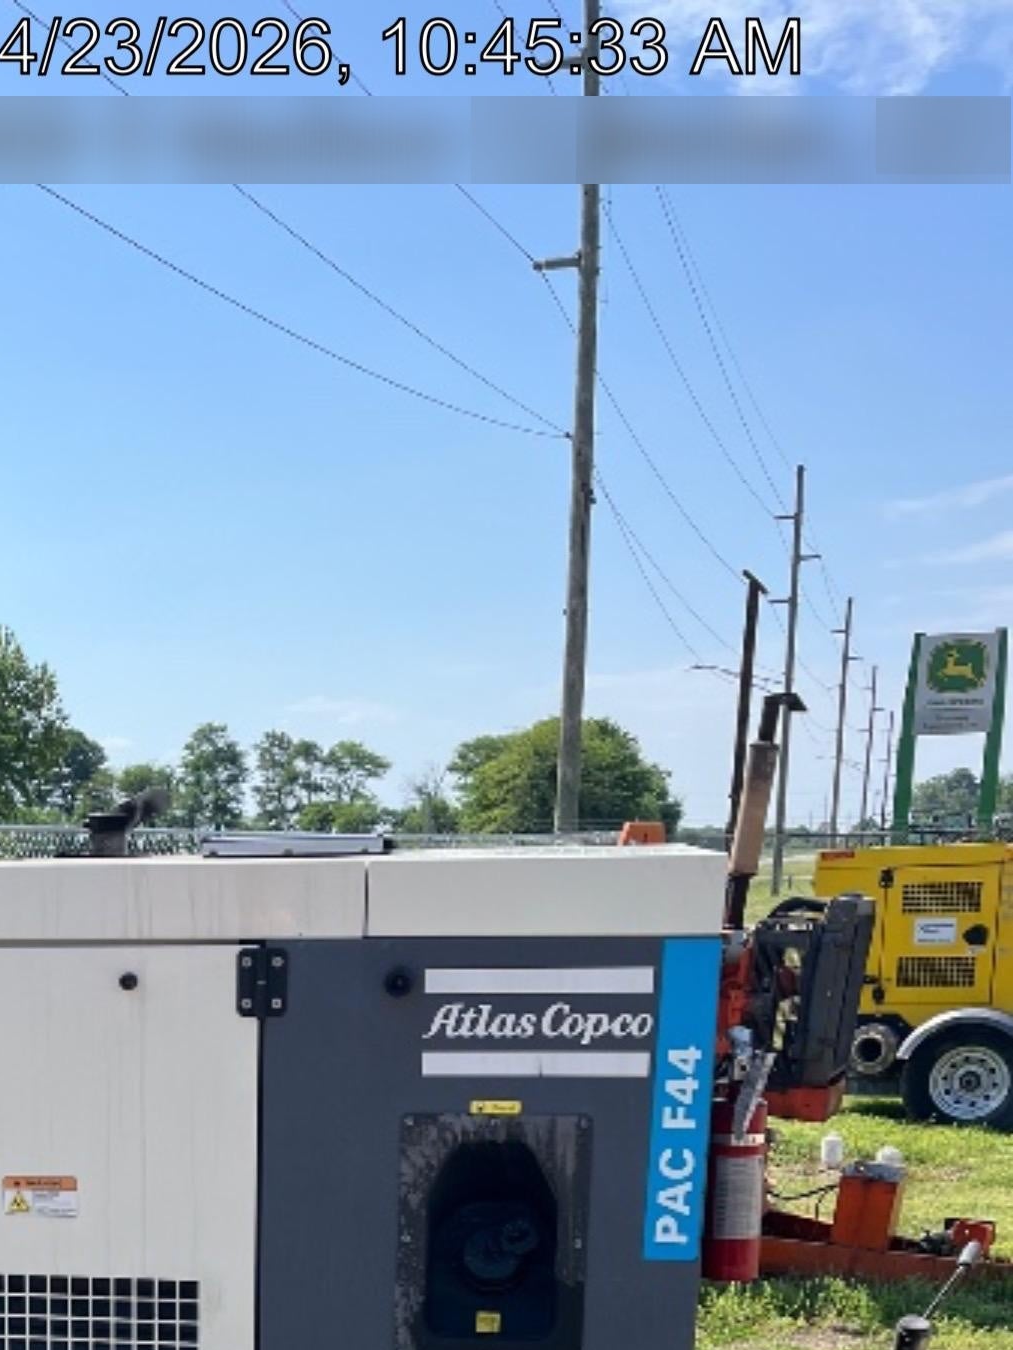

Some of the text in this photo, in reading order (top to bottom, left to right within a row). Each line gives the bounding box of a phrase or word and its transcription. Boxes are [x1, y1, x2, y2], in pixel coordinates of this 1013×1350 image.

[424, 1002, 652, 1044] Atlas Copco
[655, 1046, 702, 1244] PAC F44
